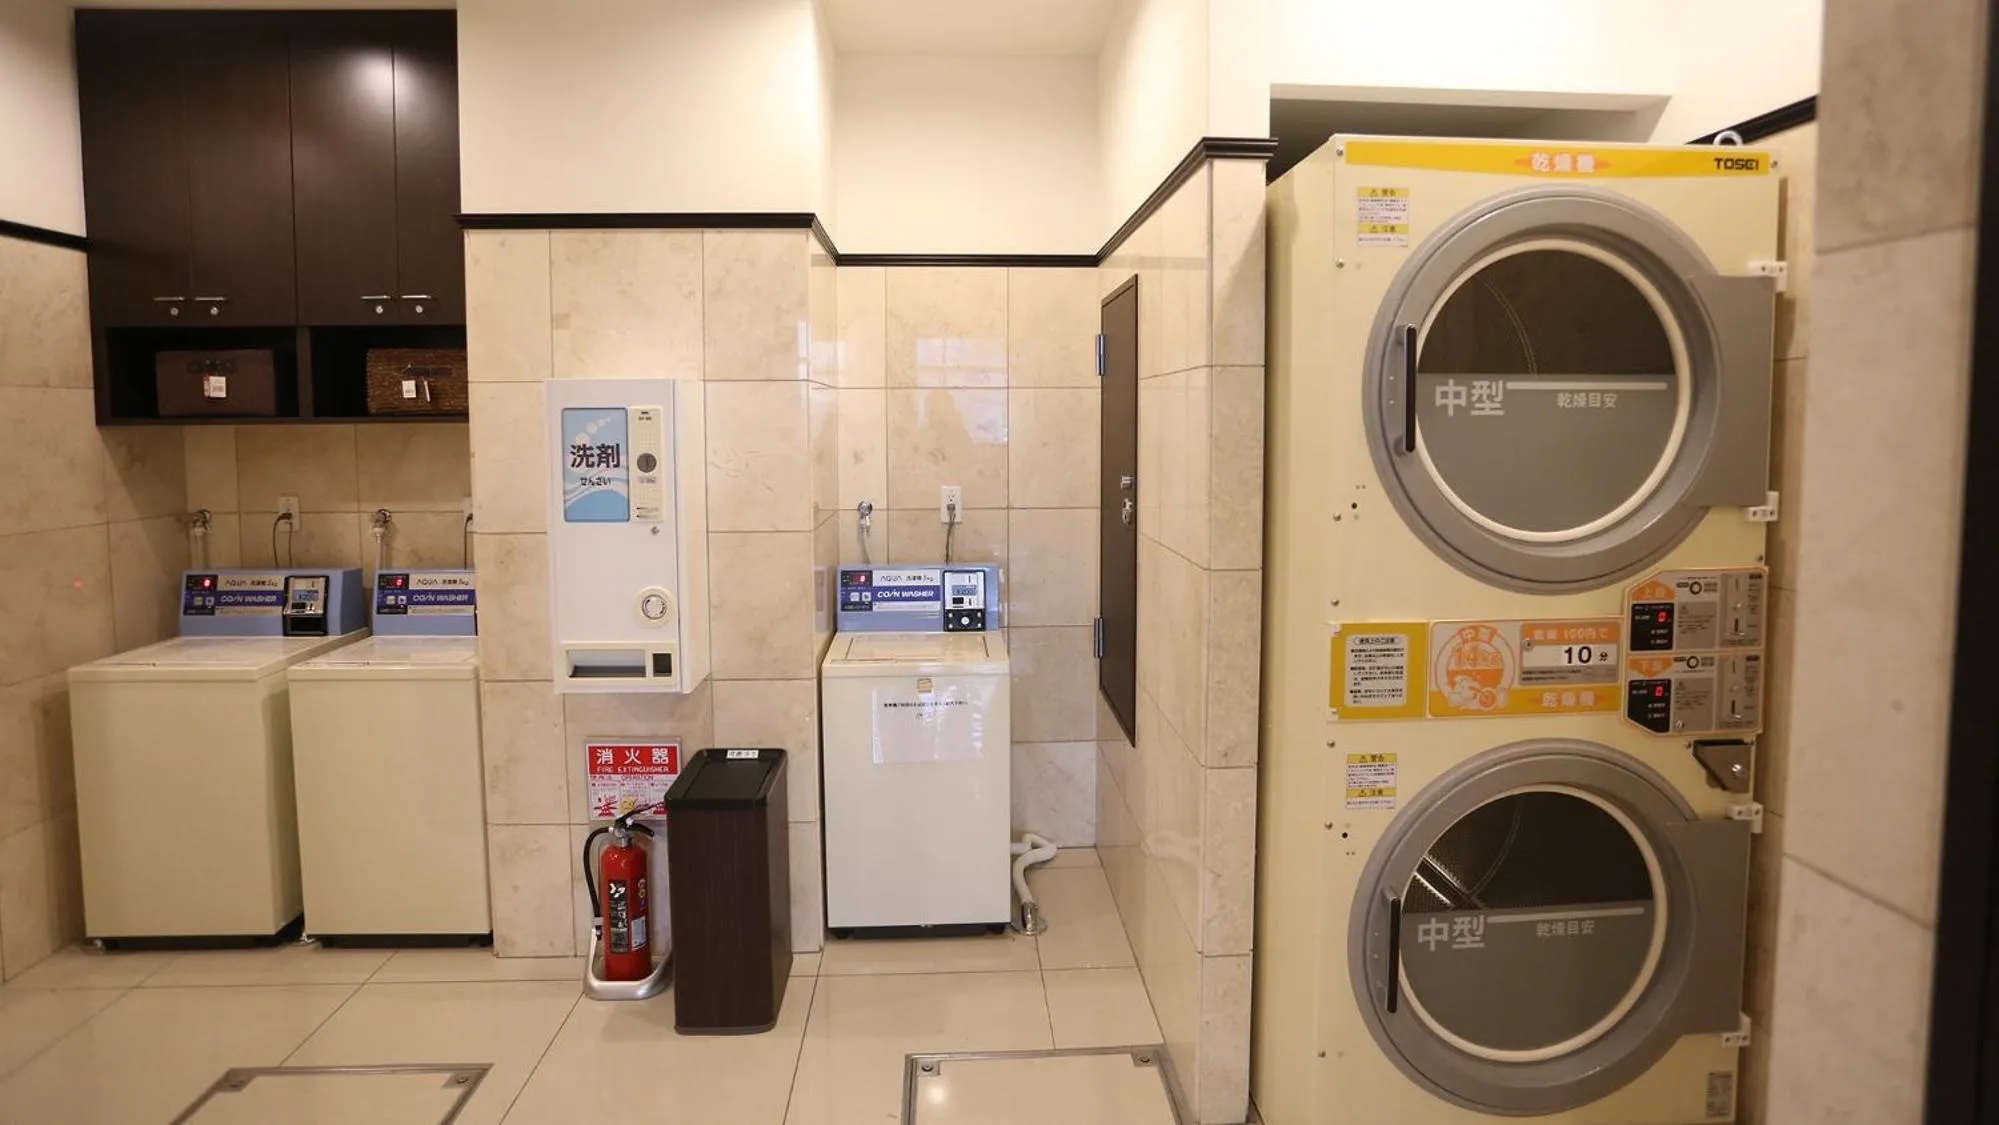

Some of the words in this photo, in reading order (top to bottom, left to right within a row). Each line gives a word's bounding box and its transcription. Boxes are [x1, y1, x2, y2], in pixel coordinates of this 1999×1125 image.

[1714, 157, 1760, 171] TOSEI
[1435, 378, 1505, 417] 中型
[1557, 392, 1617, 408] 乾燥目安
[570, 443, 621, 468] 洗剤
[580, 477, 611, 486] せんざい
[877, 588, 900, 598] COIN
[901, 590, 935, 598] WASHER
[1563, 646, 1593, 664] 10
[1598, 651, 1609, 662] 分
[596, 748, 669, 765] 消火器
[1417, 914, 1486, 952] 中型
[1536, 920, 1595, 938] 乾燥目安
